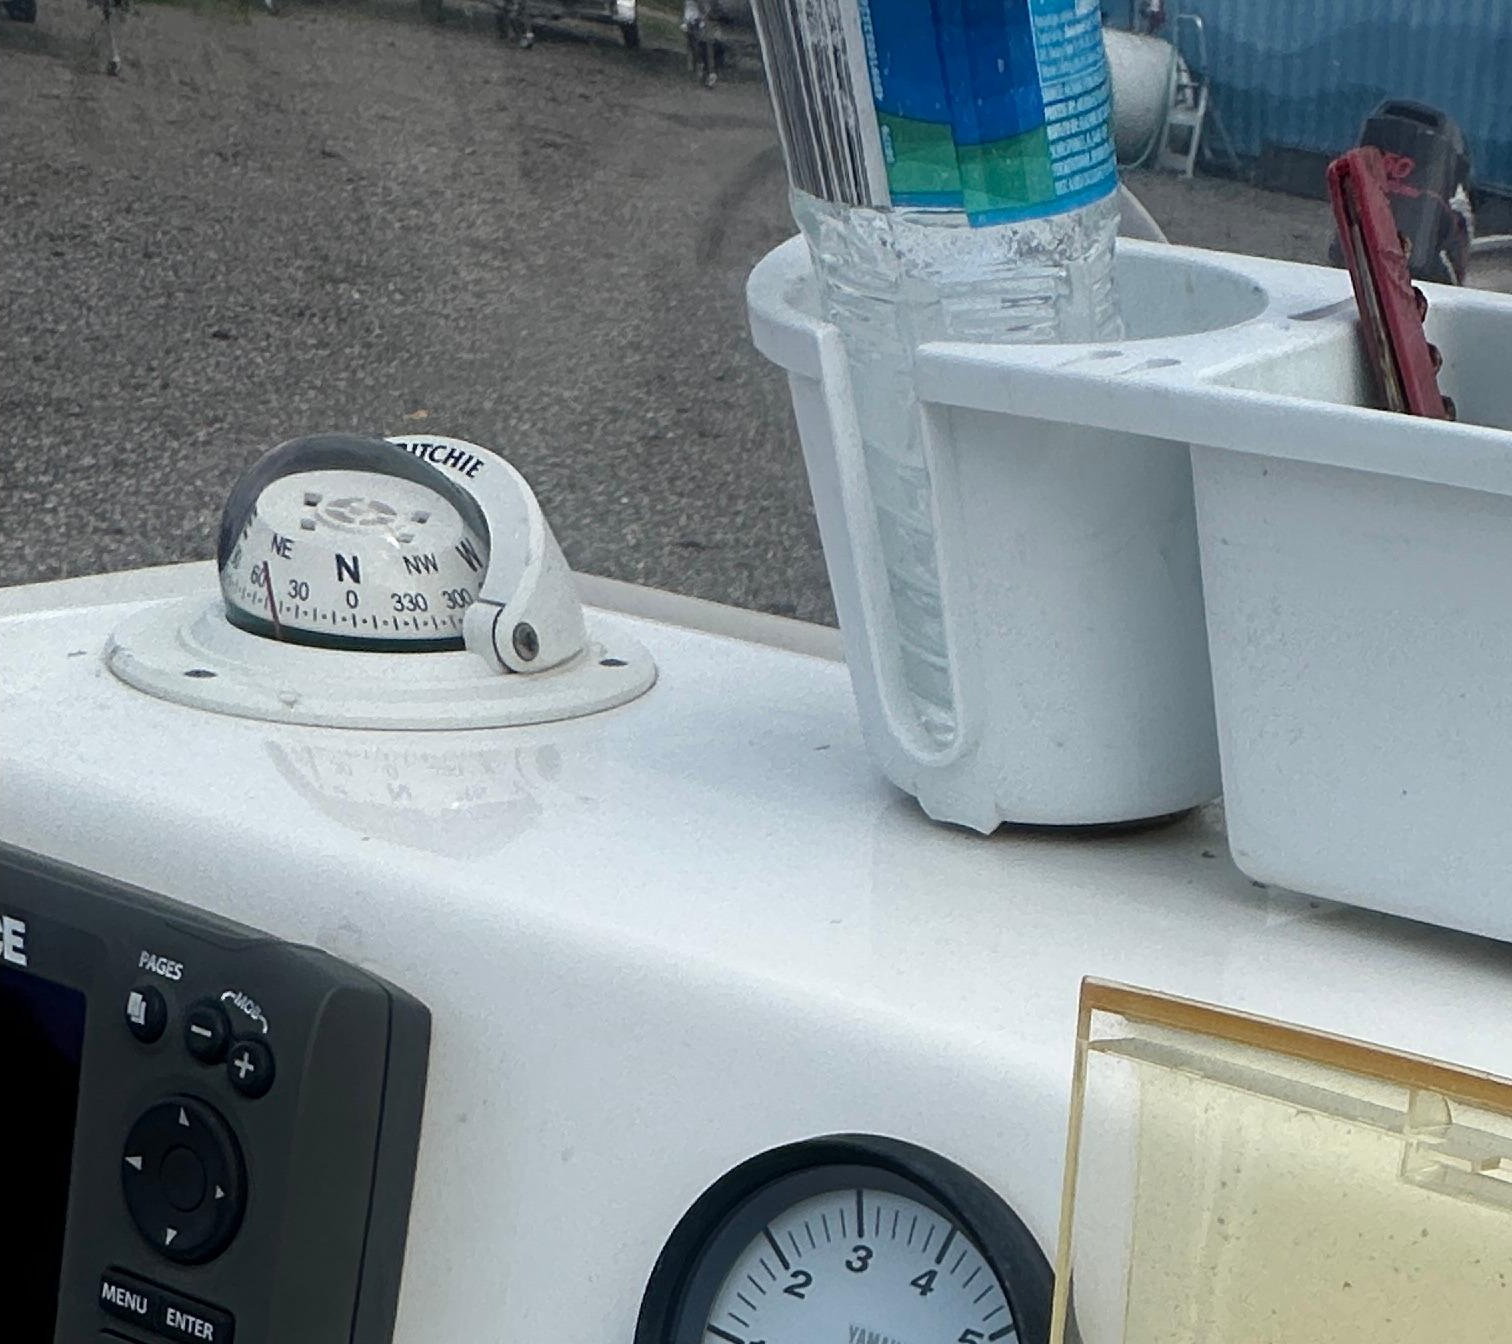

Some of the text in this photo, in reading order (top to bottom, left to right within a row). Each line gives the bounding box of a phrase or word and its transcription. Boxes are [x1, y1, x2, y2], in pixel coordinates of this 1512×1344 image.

[271, 533, 295, 560] NE
[455, 537, 484, 572] W
[335, 553, 361, 584] N
[403, 553, 439, 575] NW
[288, 579, 310, 601] 30
[346, 589, 359, 609] 0
[391, 592, 428, 612] 330
[442, 588, 473, 610] 300
[138, 950, 184, 981] PAGES
[845, 1244, 874, 1273] 3
[784, 1269, 814, 1300] 2
[910, 1269, 940, 1297] 4
[101, 1282, 215, 1342] MENU ENTER
